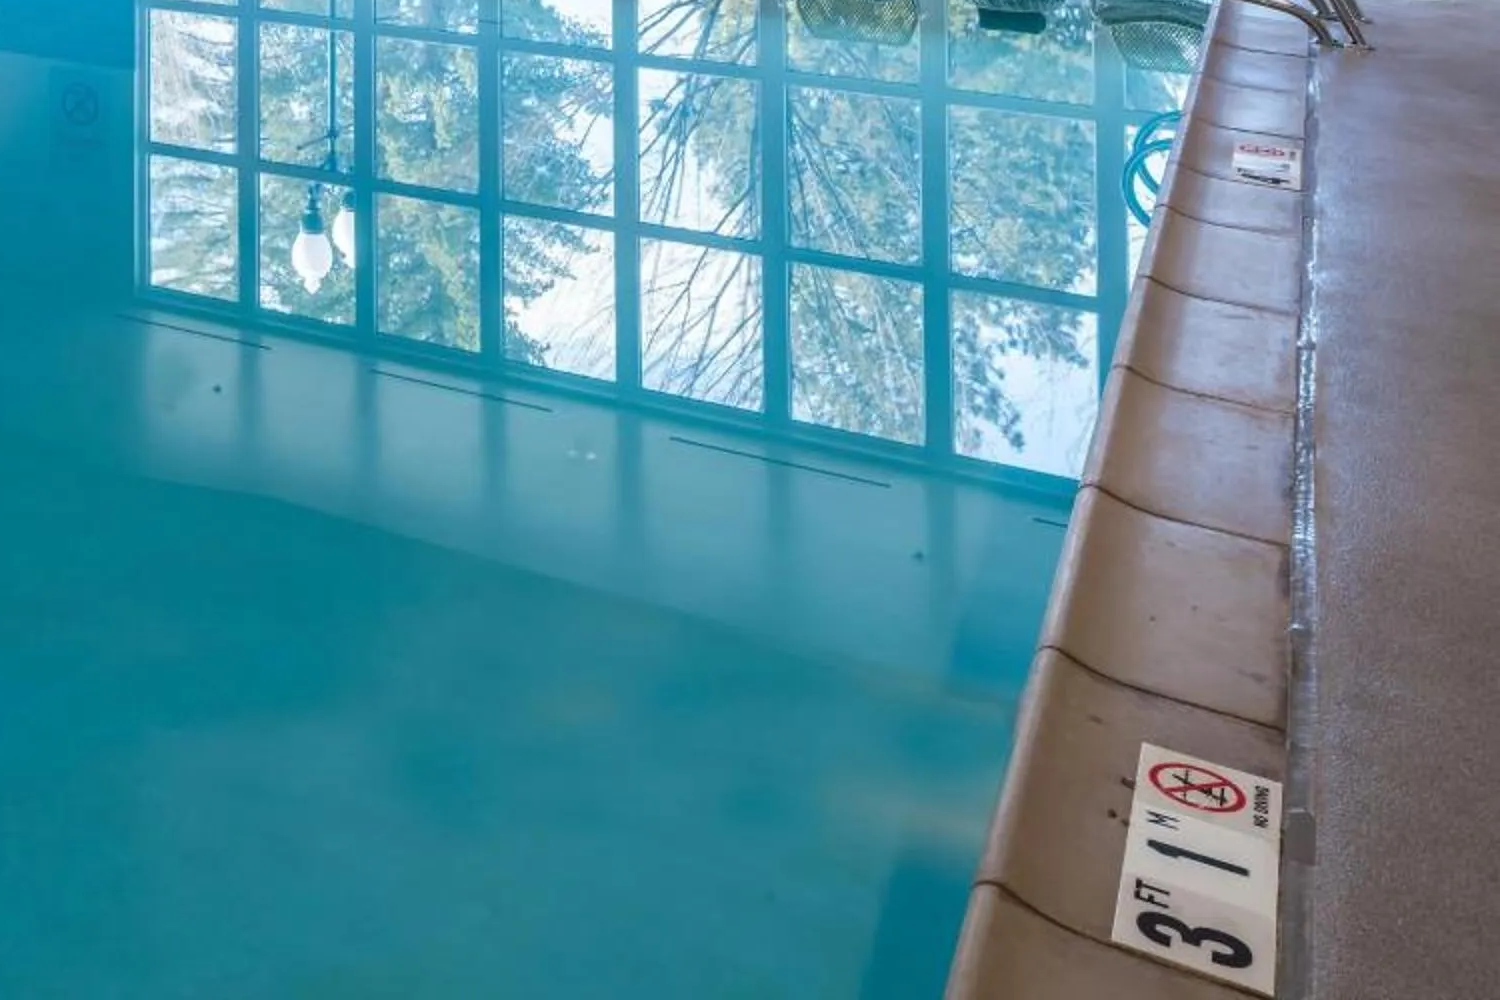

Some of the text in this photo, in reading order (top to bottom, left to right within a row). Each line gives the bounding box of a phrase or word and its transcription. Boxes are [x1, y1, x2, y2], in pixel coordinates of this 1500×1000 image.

[1147, 810, 1249, 876] 1 M
[1134, 878, 1253, 968] 3 FT
